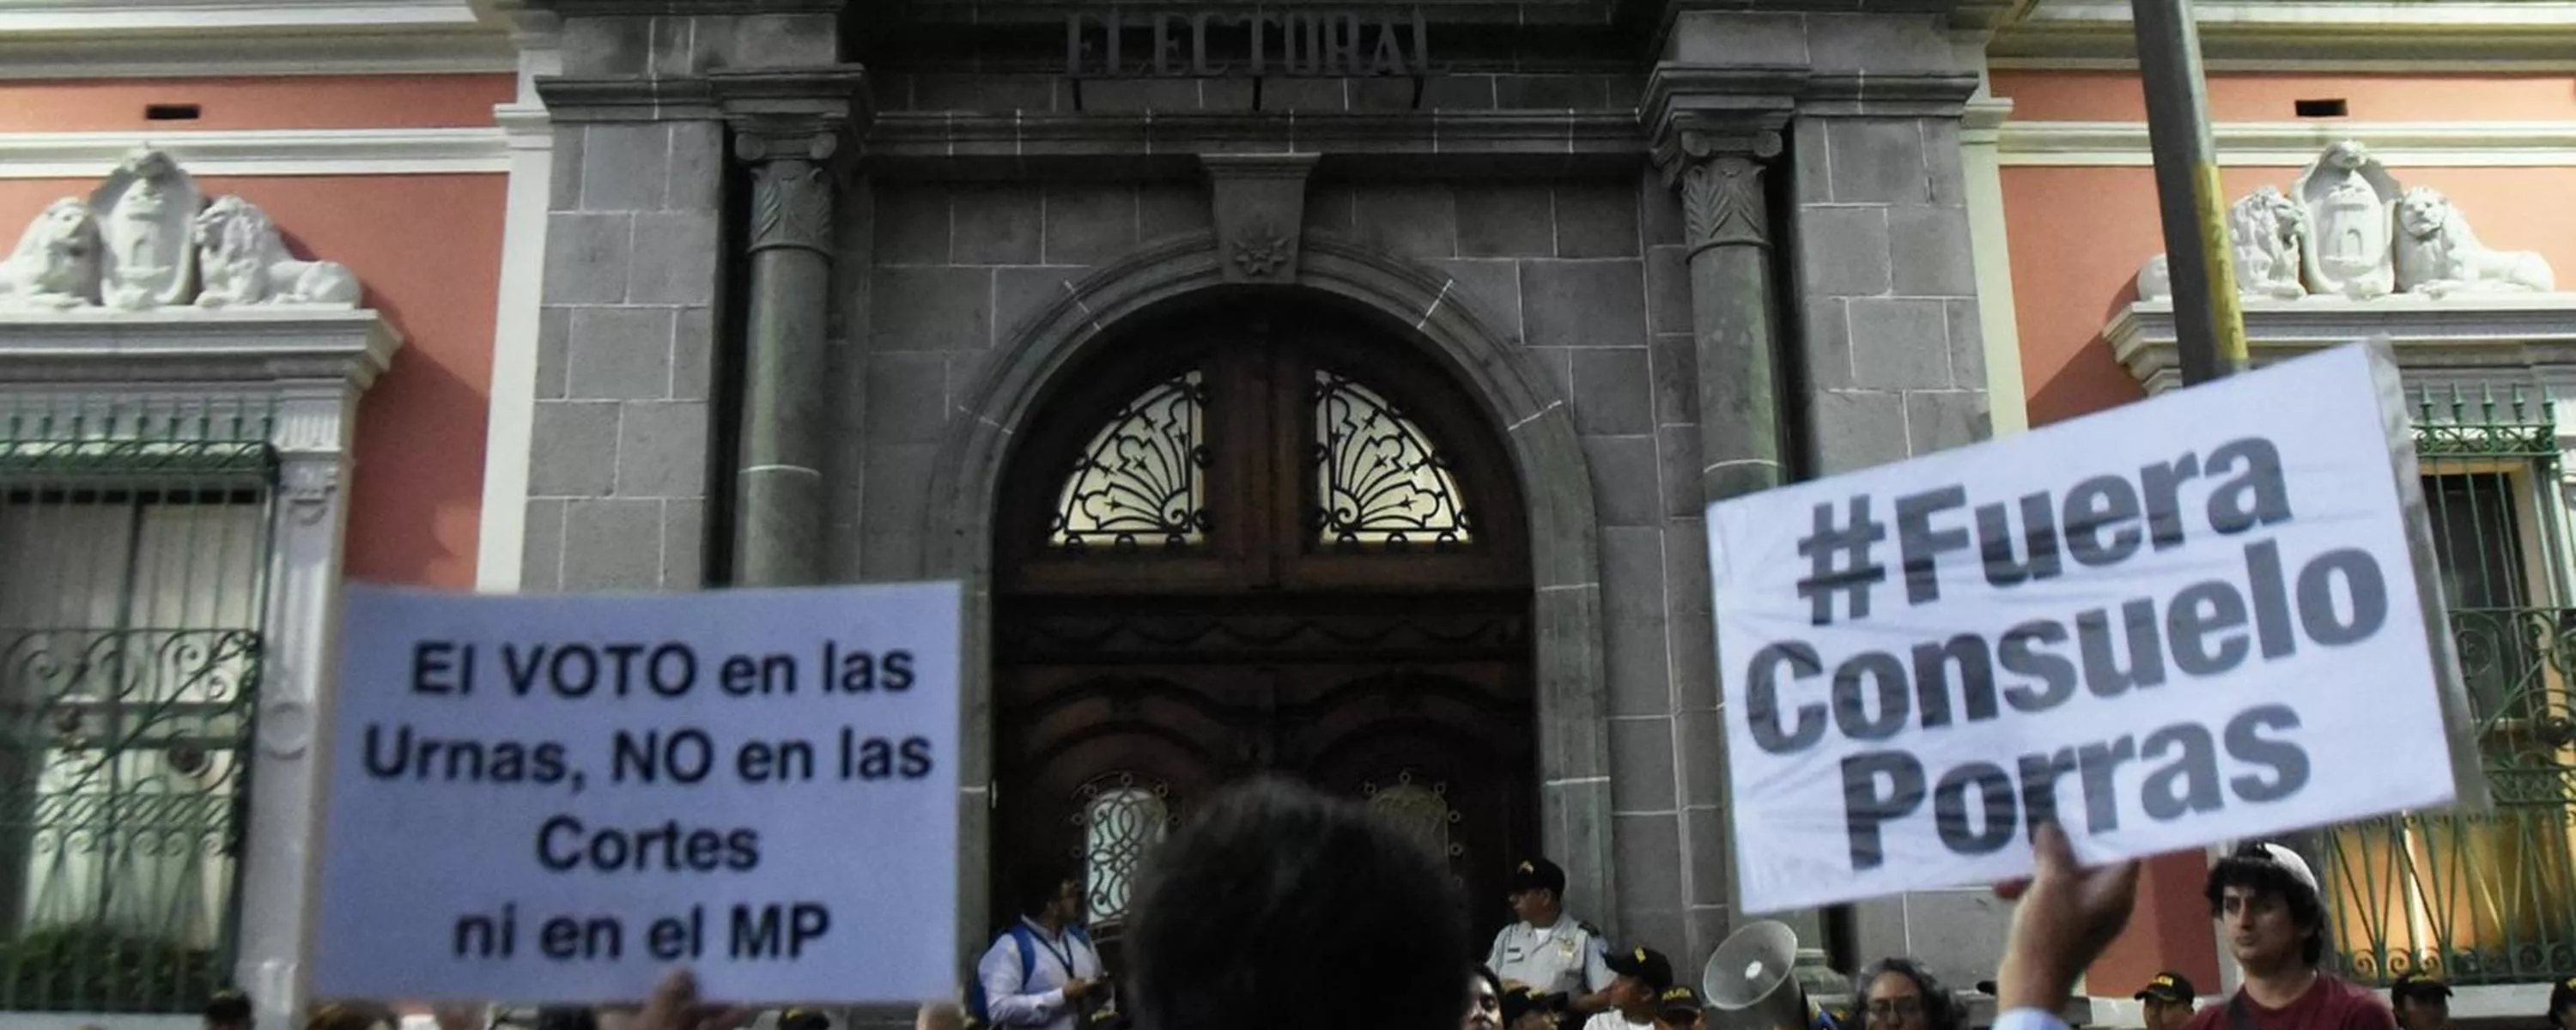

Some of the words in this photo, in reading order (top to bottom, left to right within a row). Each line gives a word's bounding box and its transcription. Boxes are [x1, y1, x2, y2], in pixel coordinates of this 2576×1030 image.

[1797, 436, 2293, 626] #Fuera
[411, 640, 476, 696] El
[501, 642, 698, 700] VOTO
[718, 653, 798, 698] en
[822, 639, 915, 695] las
[1746, 537, 2389, 754] Consuelo
[362, 723, 585, 792] Urnas,
[611, 728, 714, 785] NO
[735, 740, 815, 785] en
[839, 725, 933, 782] las
[1840, 704, 2311, 871] Porras
[535, 813, 760, 874] Cortes
[453, 903, 517, 960] ni
[538, 916, 623, 962] en
[646, 904, 705, 962] el
[729, 902, 831, 960] MP
